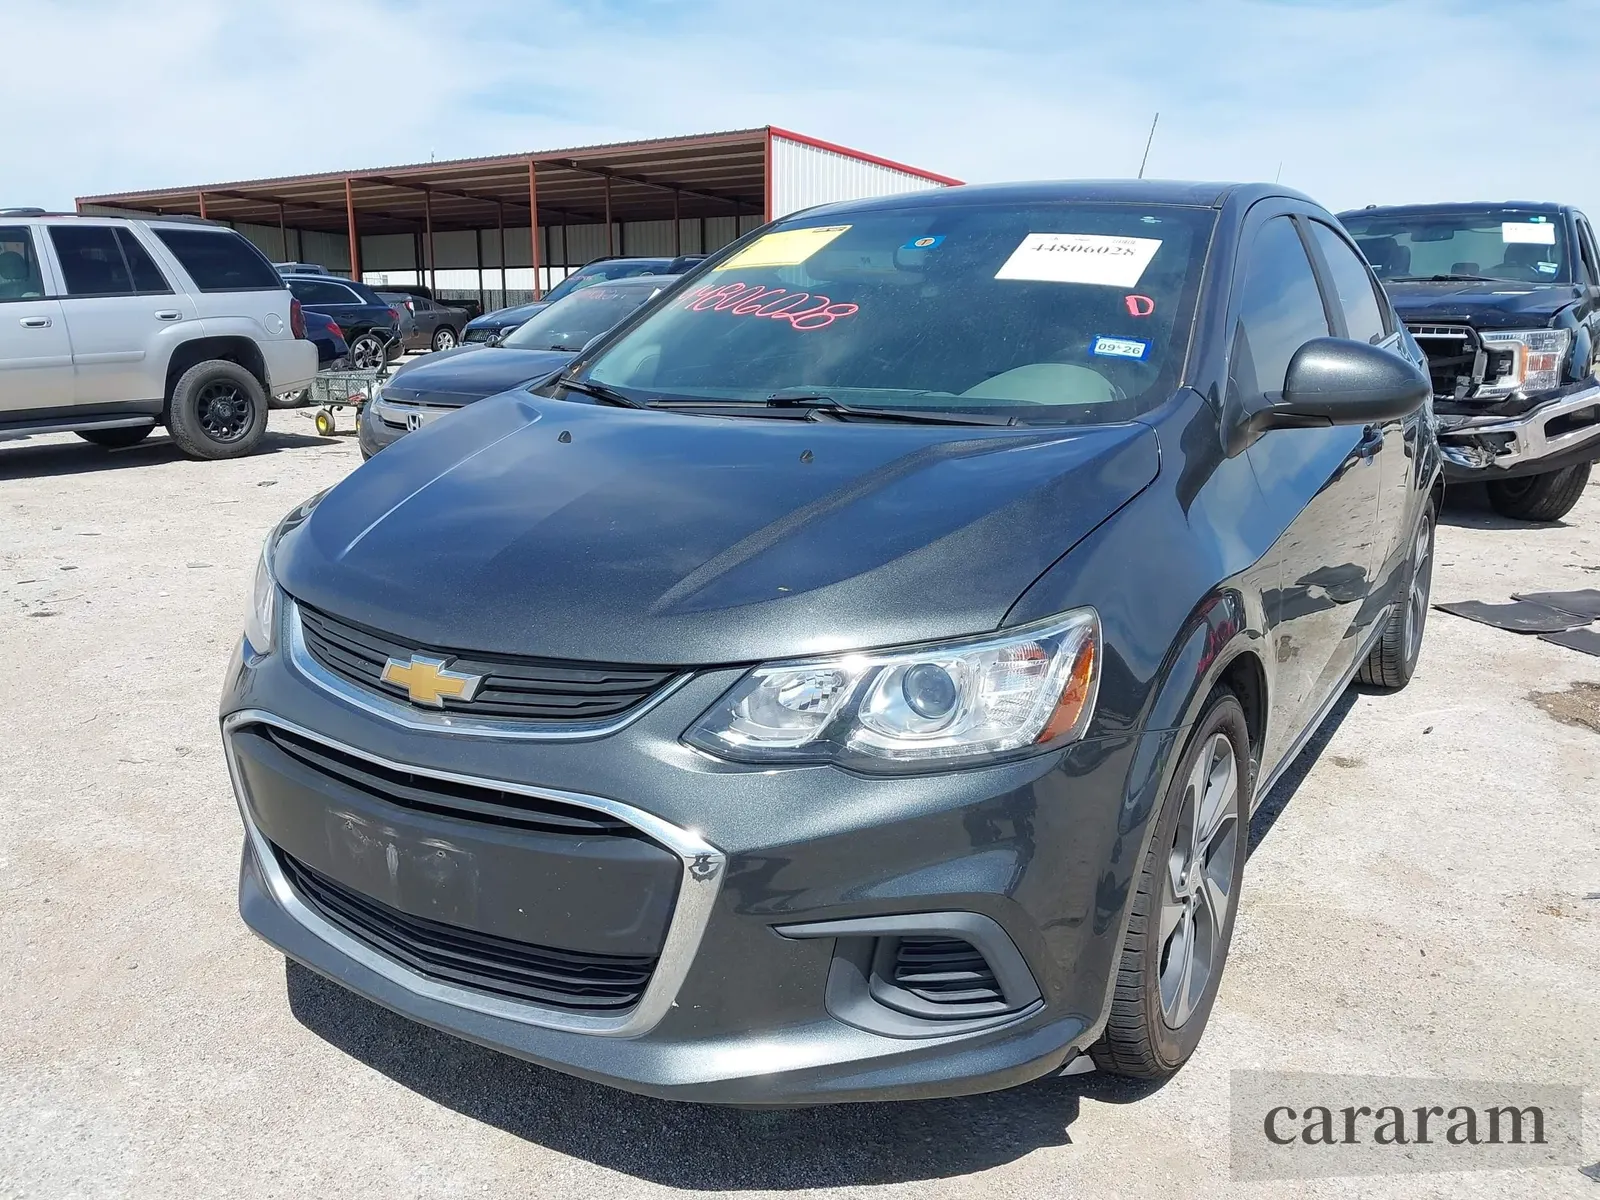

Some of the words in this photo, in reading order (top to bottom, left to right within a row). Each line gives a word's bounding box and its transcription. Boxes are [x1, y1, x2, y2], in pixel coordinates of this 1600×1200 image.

[1032, 243, 1136, 255] 44806028
[1125, 295, 1154, 316] D
[1098, 343, 1116, 351] 09
[1122, 346, 1141, 355] 26
